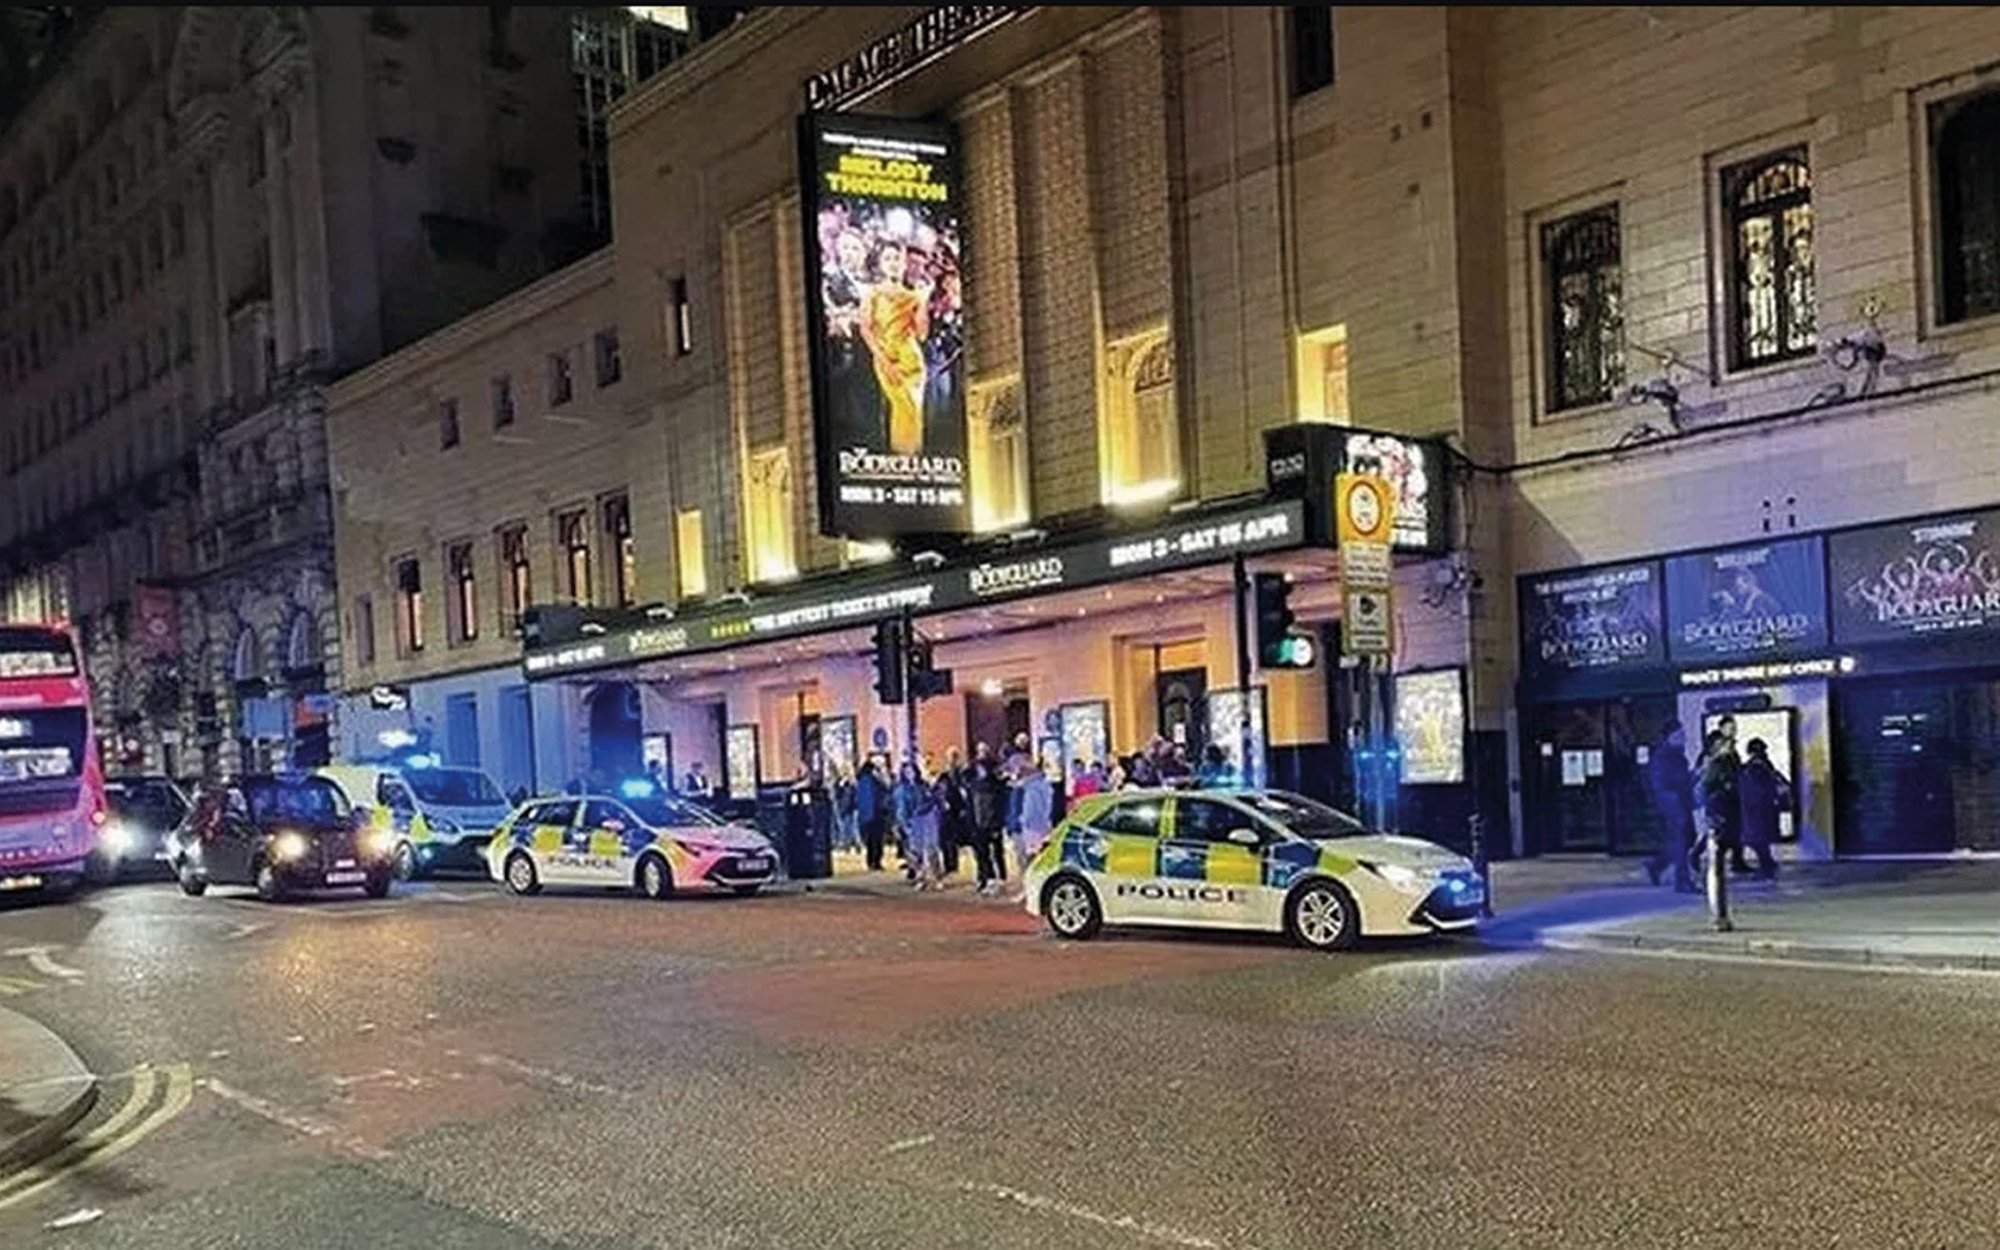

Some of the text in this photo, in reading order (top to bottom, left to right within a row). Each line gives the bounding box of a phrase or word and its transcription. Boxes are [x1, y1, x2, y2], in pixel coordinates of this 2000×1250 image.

[839, 156, 933, 181] MELODY
[826, 172, 948, 202] THORNTON
[839, 451, 963, 474] BODYGUARD
[1180, 528, 1216, 554] SAT
[1245, 513, 1289, 542] APR
[1876, 592, 2000, 621] BODYGUAR
[1117, 884, 1247, 903] POLICE
